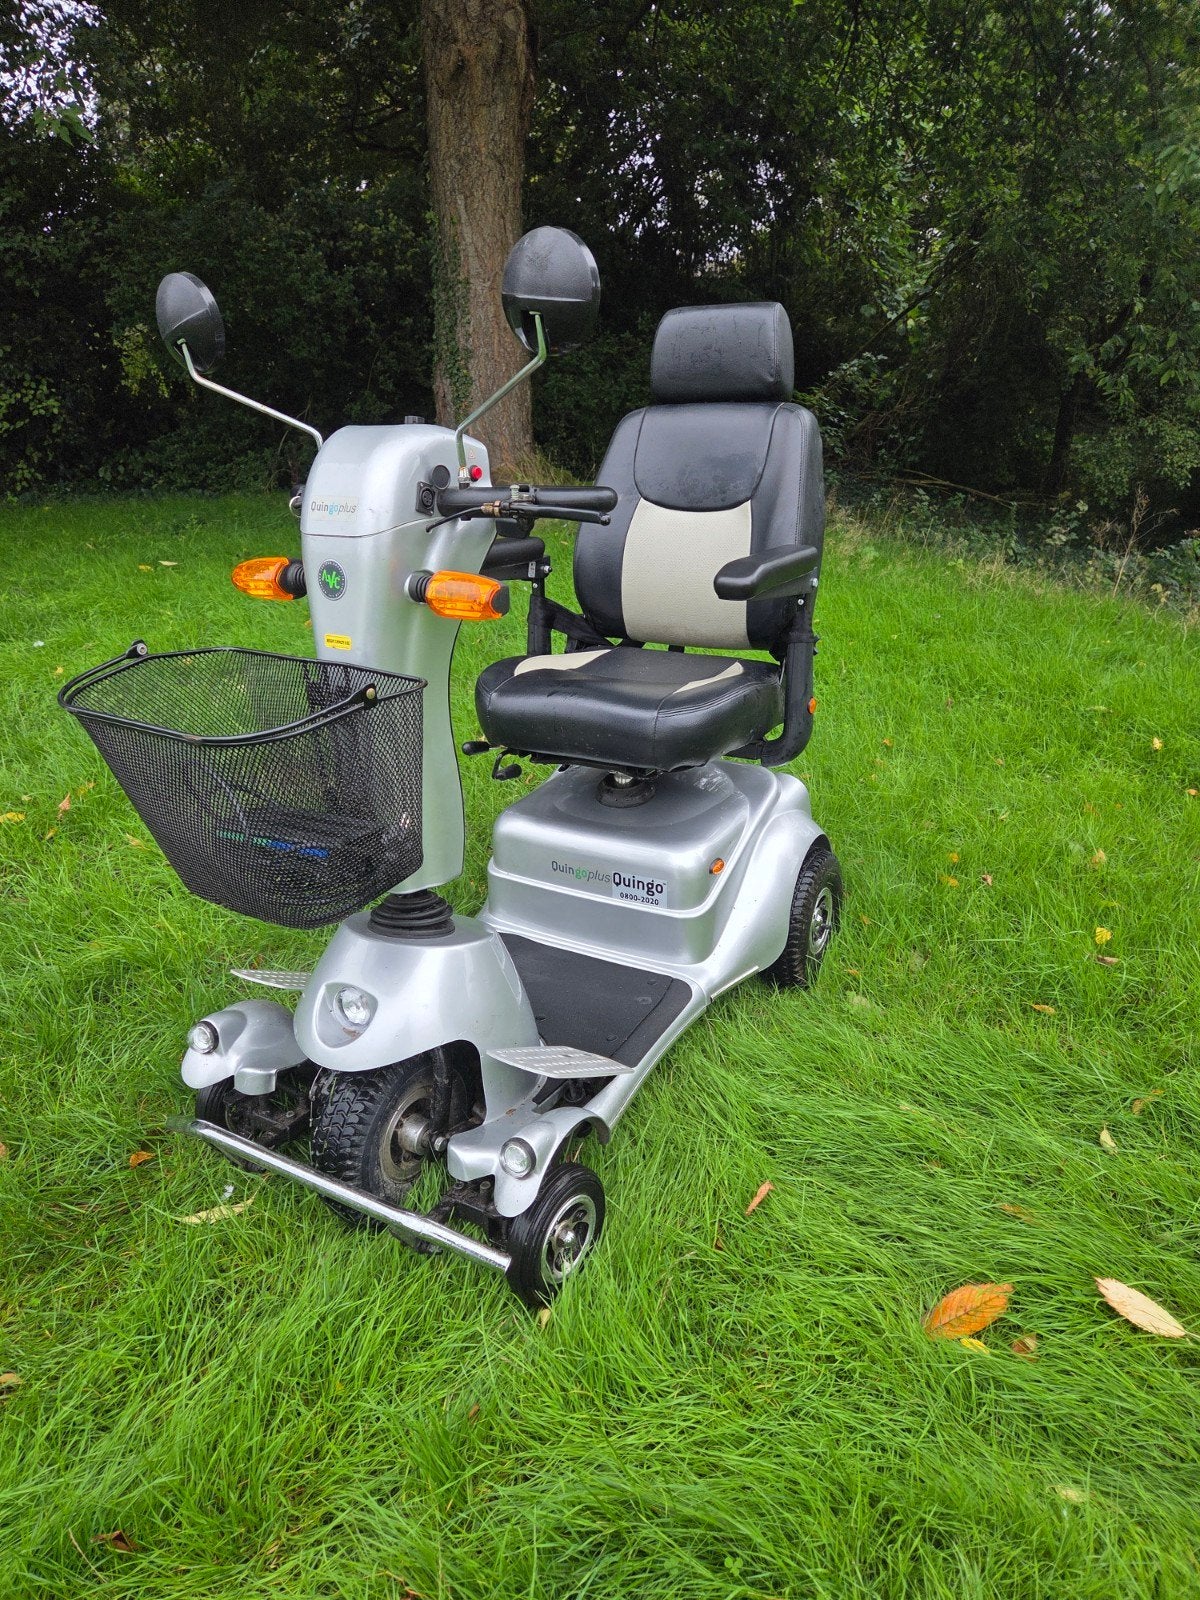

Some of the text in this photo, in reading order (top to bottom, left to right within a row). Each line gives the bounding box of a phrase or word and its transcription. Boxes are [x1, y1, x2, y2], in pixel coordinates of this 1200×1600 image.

[311, 501, 357, 515] Quingoplus
[552, 861, 611, 882] Quingoplus
[620, 892, 659, 906] 0800-2020
